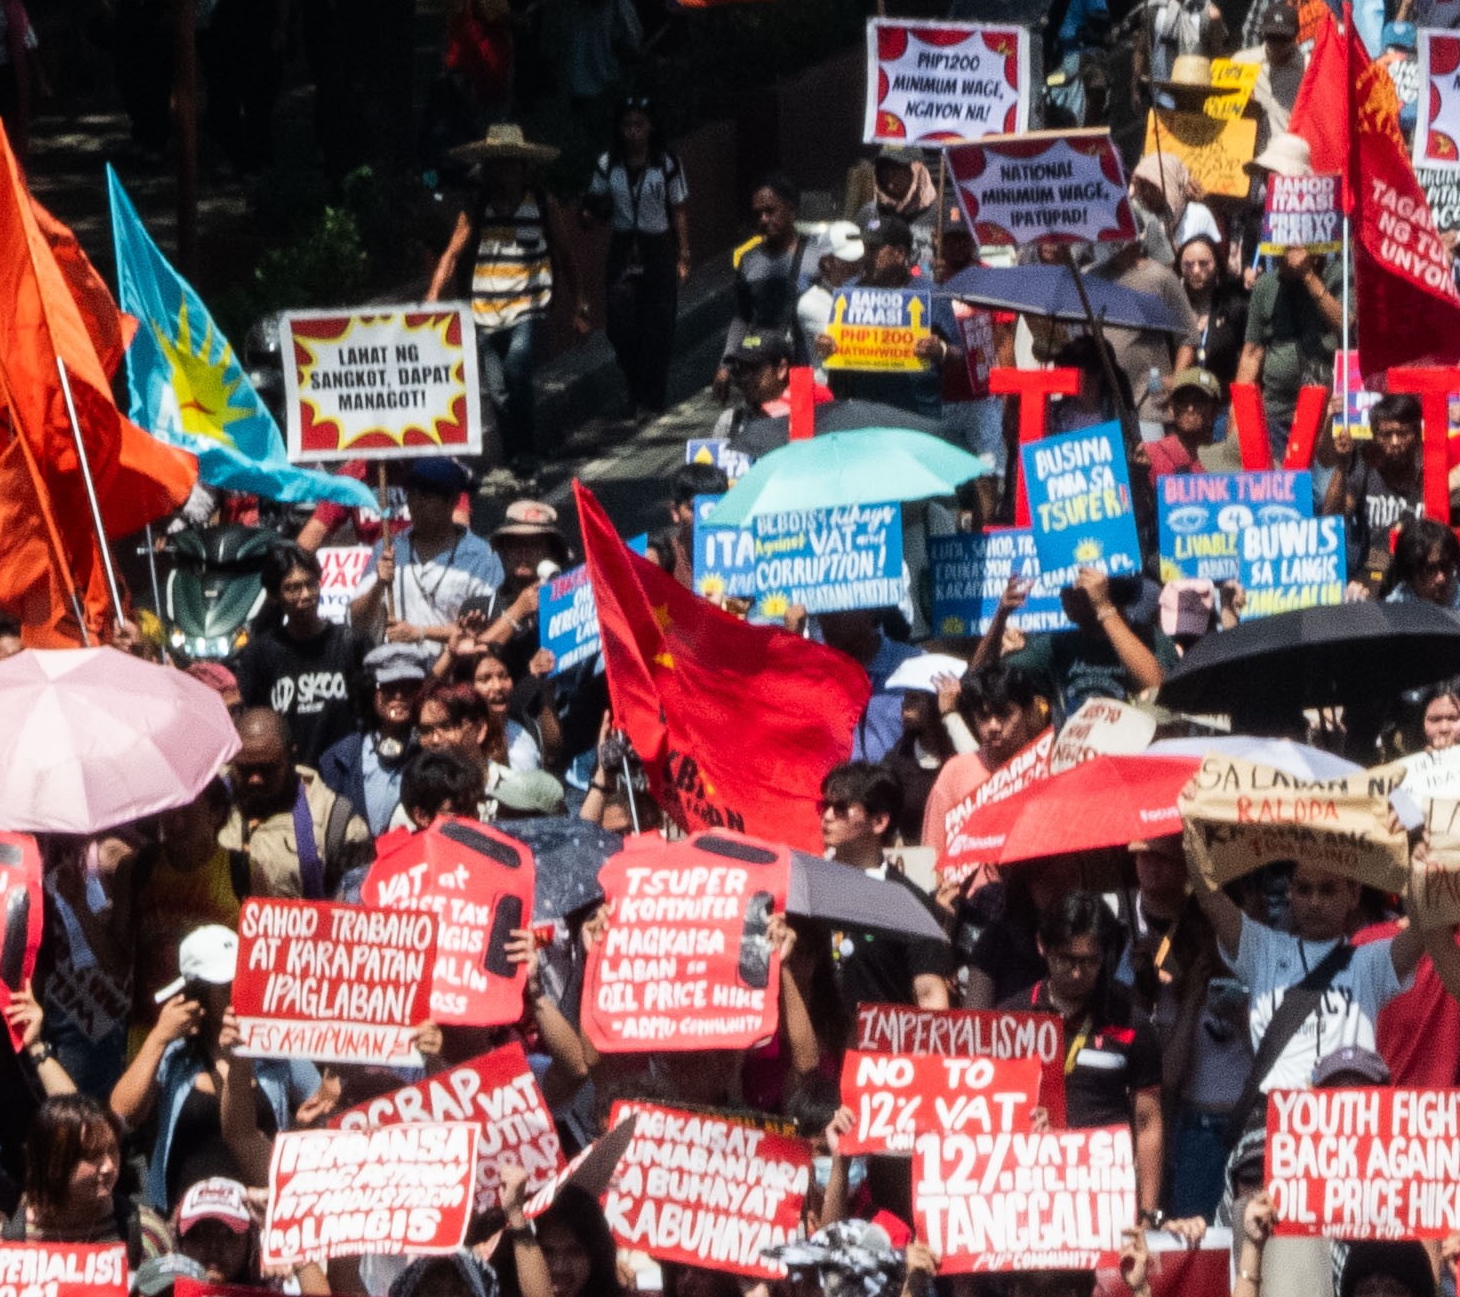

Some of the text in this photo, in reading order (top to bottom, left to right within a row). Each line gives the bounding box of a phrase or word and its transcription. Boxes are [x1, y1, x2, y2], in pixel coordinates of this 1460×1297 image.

[916, 53, 981, 73] PHP1200
[892, 76, 957, 96] MINIMUM
[904, 100, 991, 122] NGAYON NA!
[999, 162, 1073, 184] NATIONAL
[981, 184, 1056, 207] MINIMUM
[1009, 206, 1089, 227] IPATUPAD!
[849, 291, 903, 311] SAHOD
[840, 328, 914, 345] PHP1200
[337, 343, 420, 366] LAHAT NG
[310, 364, 452, 391] SANGKOT, DAPAT
[338, 390, 428, 412] MANAGOT!
[1034, 435, 1113, 476] BUSINA
[1164, 473, 1295, 503] BLINK TWICE
[1243, 521, 1339, 558] BUWIS
[756, 549, 886, 590] CORRUPTION!
[1251, 555, 1338, 583] SA LANGIS
[376, 863, 431, 908] VAT
[625, 866, 749, 897] TSUPER
[242, 901, 433, 953] SAHOD TRABAHO
[604, 926, 726, 957] MAGKAISA
[249, 938, 423, 982] AT KARAPATAN
[262, 971, 417, 1025] IPAGLABAN!
[598, 980, 765, 1013] OIL PRICE HIKE
[858, 1007, 1059, 1064] IMPERYALISMO
[856, 1058, 994, 1090] NO TO
[856, 1093, 1028, 1143] 12% VAT
[1273, 1091, 1380, 1136] YOUTH
[921, 1194, 1135, 1254] TANGGALIN
